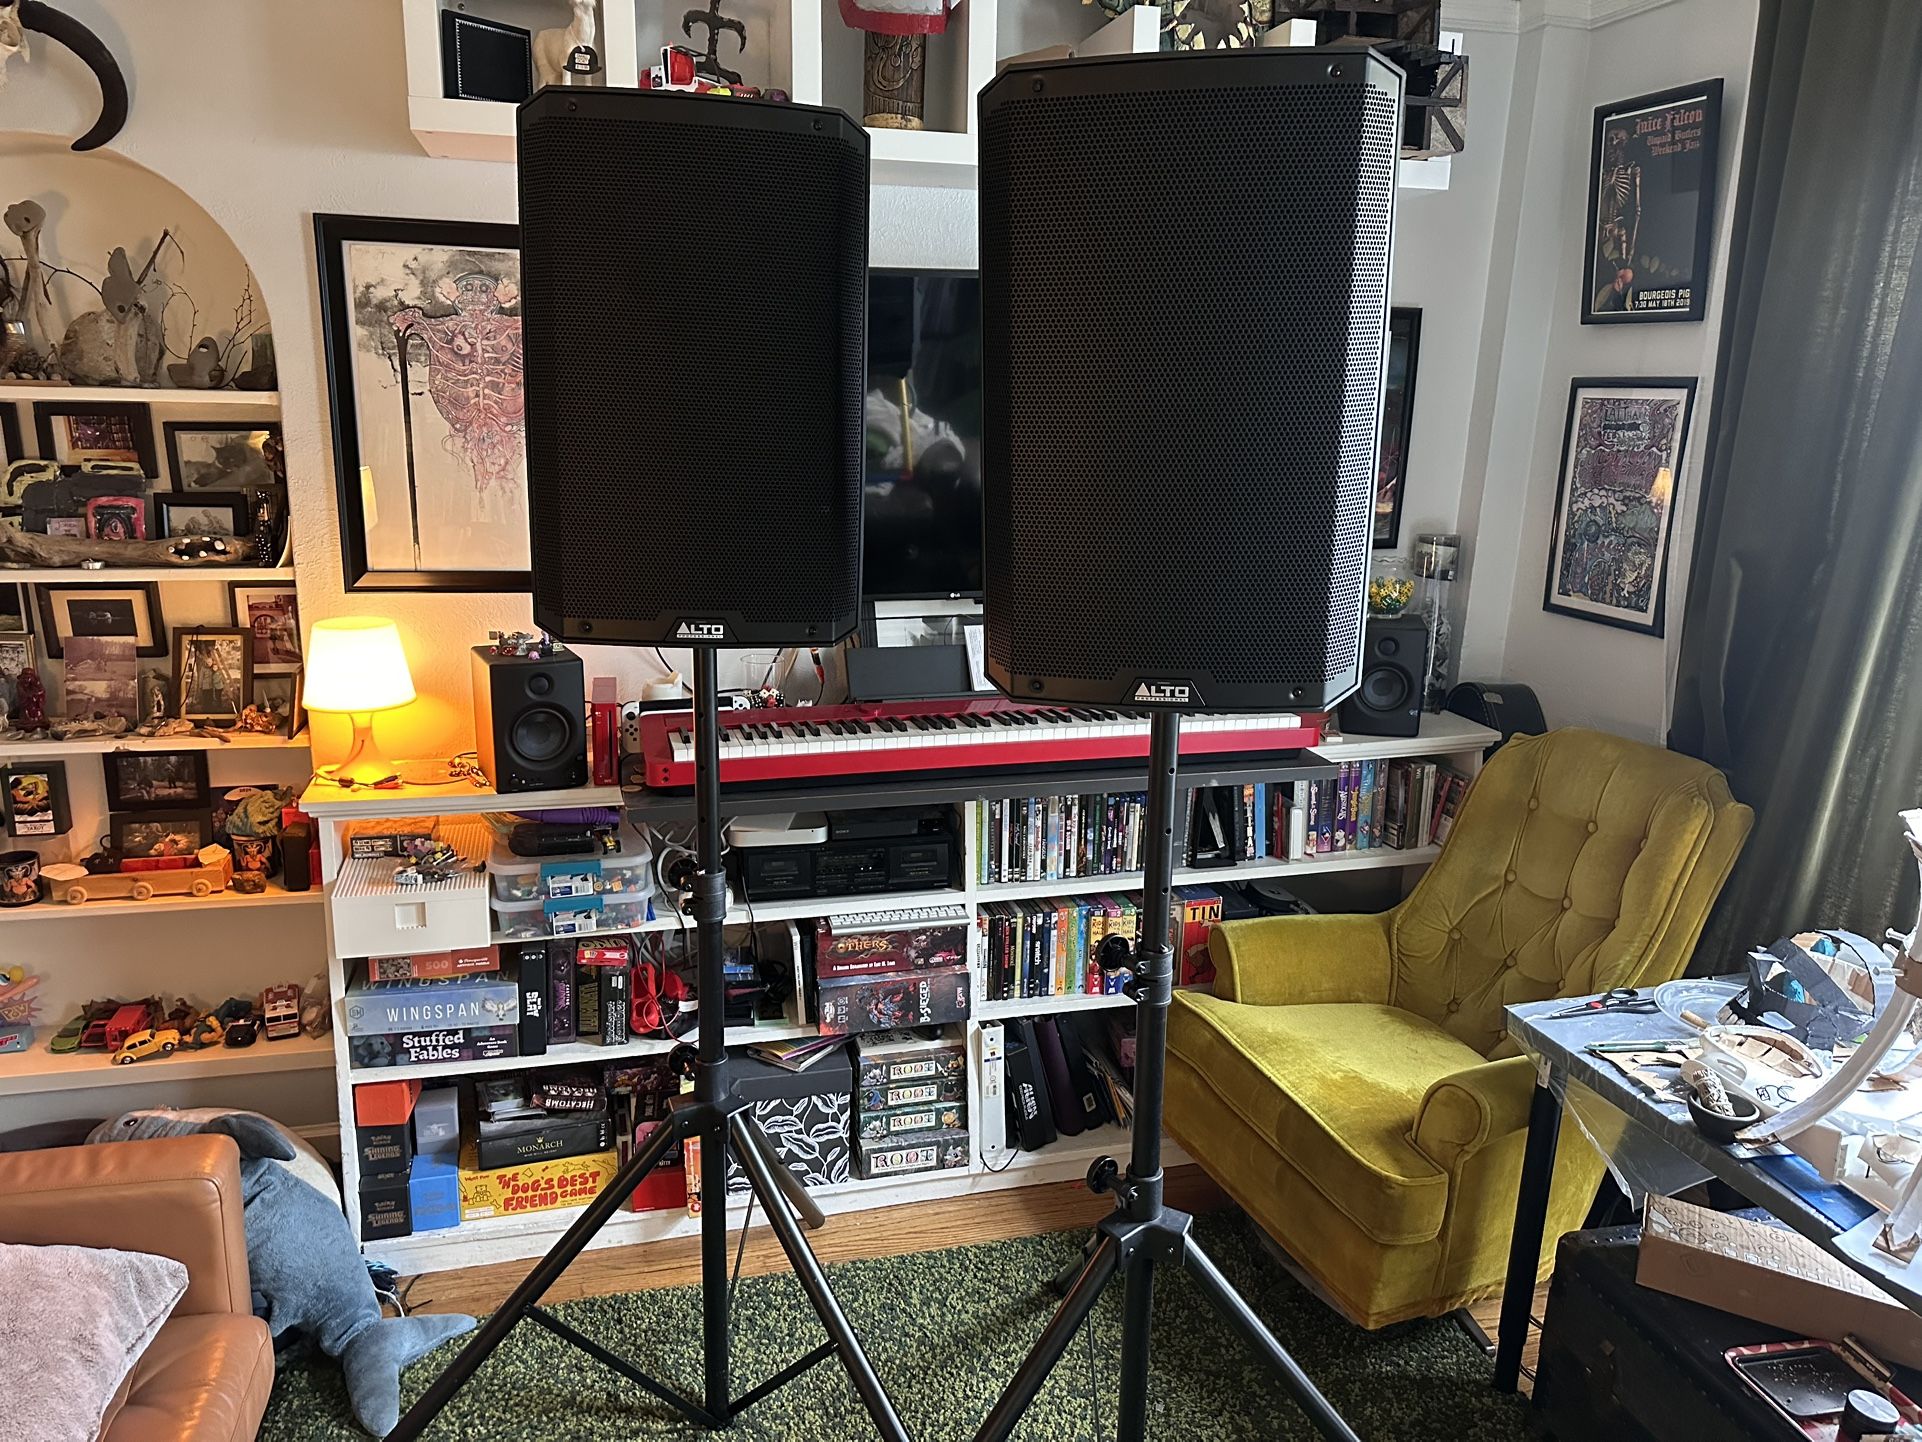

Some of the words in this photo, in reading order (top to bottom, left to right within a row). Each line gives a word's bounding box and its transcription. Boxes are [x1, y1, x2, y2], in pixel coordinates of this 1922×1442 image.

[1632, 116, 1662, 138] Juice
[1664, 109, 1703, 132] Falcon
[1639, 289, 1676, 301] BOURGEOIS
[1678, 288, 1690, 298] PIG
[1647, 300, 1660, 308] MAY
[676, 621, 724, 635] ALTO
[1134, 682, 1190, 698] ALTO
[1190, 904, 1220, 921] TIN
[425, 960, 449, 970] 500
[386, 1001, 480, 1023] WINGSPAN
[525, 991, 540, 1018] SLAY
[402, 1029, 465, 1048] Stuffed
[409, 1045, 460, 1062] Fables
[891, 1061, 935, 1076] ROOT
[889, 1086, 936, 1101] ROOT
[545, 1098, 595, 1109] HECATOMB
[891, 1113, 935, 1128] ROOT
[517, 1139, 563, 1154] MONARCH
[872, 1148, 935, 1168] ROOT
[496, 1172, 520, 1190] THE
[510, 1176, 555, 1196] DOG'S
[557, 1170, 601, 1190] BEST
[503, 1190, 559, 1212] FRIEND
[559, 1185, 598, 1199] GAME
